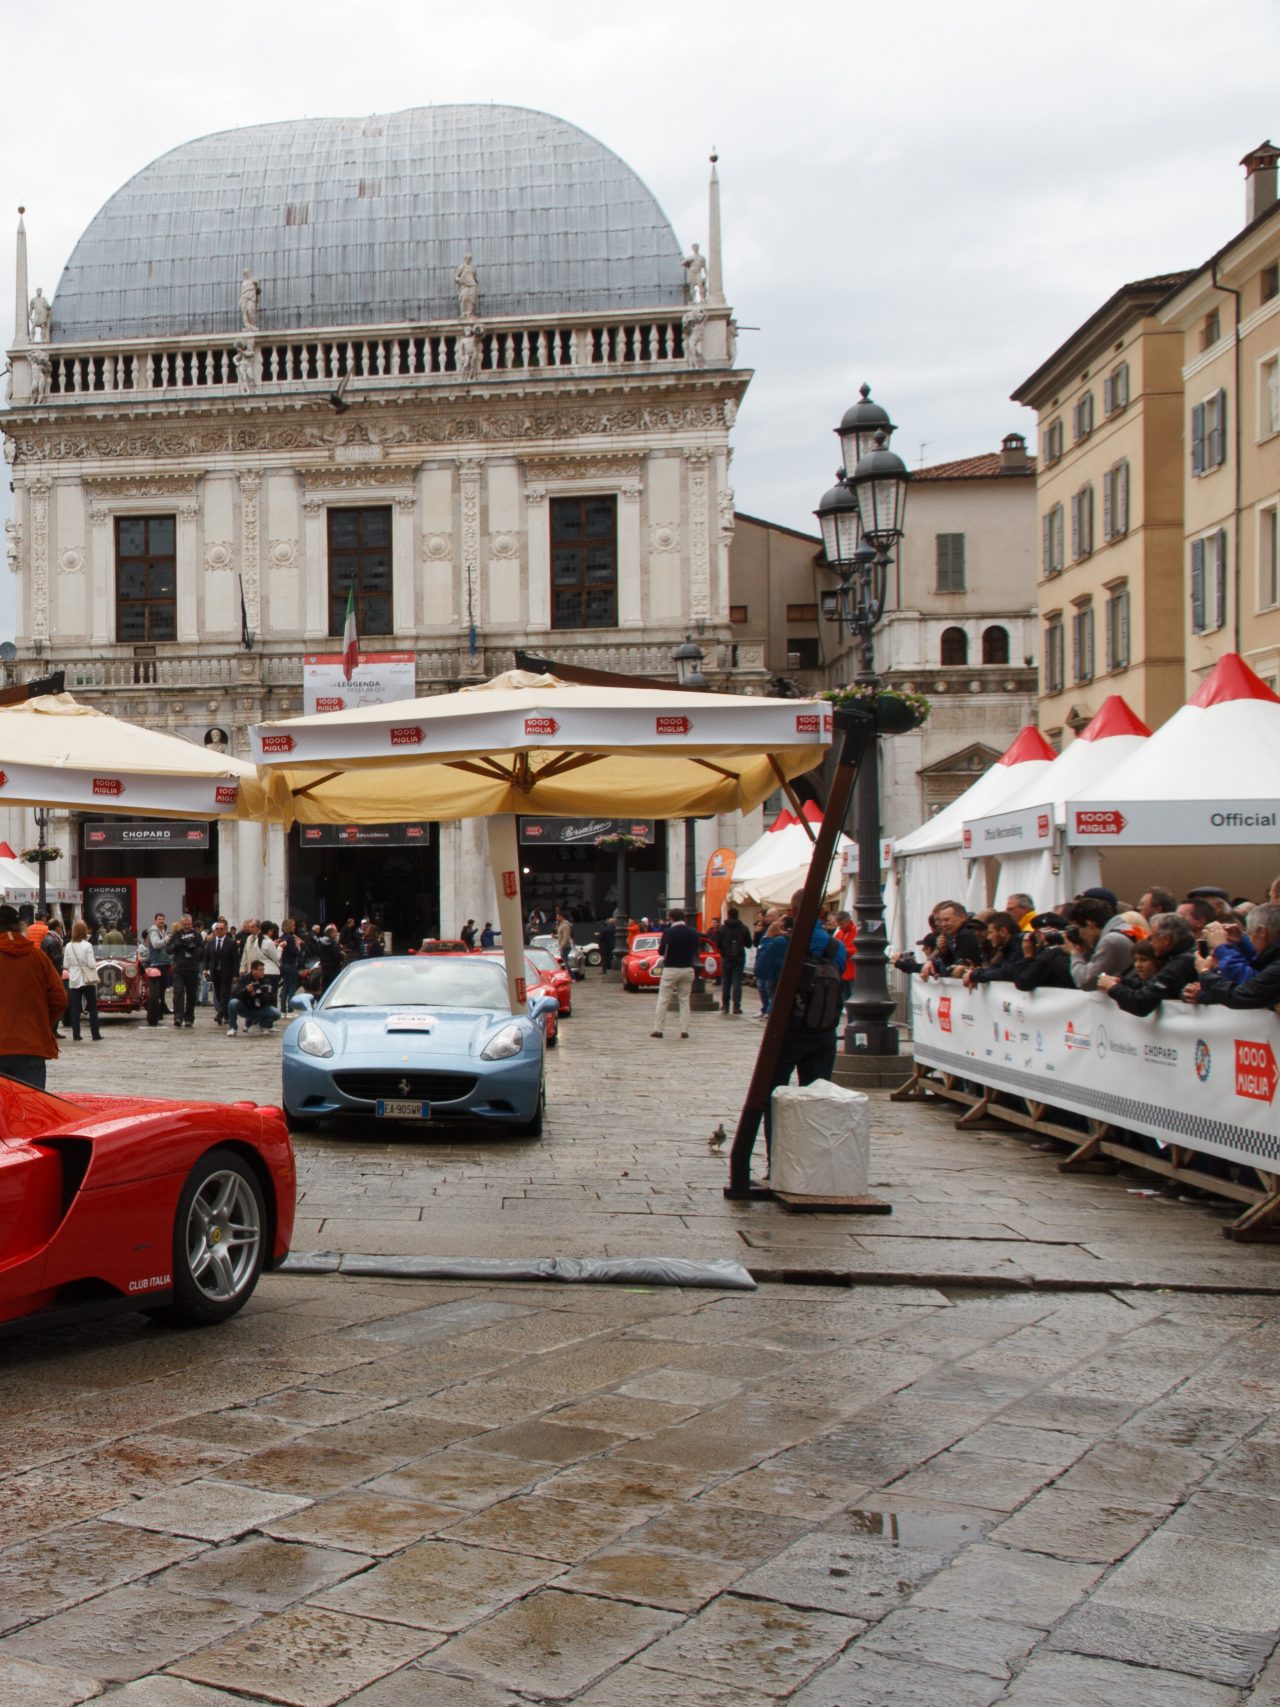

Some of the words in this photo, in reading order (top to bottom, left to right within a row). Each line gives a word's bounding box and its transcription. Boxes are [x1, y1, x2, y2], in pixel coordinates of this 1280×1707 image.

[319, 697, 339, 705] 1000
[659, 717, 683, 725] 1000
[393, 728, 417, 736] 1000
[526, 725, 552, 734] MIGLIA
[658, 725, 686, 733] MIGLIA
[392, 736, 418, 744] MIGLIA
[263, 744, 289, 752] MIGLIA
[95, 779, 117, 787] 1000
[93, 787, 118, 795] MIGLIA
[1079, 812, 1115, 822] 1000
[1210, 812, 1276, 827] Official
[561, 820, 612, 840] Borsalino
[1078, 823, 1118, 833] MIGLIA
[122, 830, 171, 838] CHOPARD
[88, 886, 127, 894] CHOPARD
[1144, 1044, 1178, 1061] CHOPARD
[1239, 1046, 1267, 1068] 1000
[1237, 1072, 1270, 1097] MIGLIA
[129, 1279, 148, 1291] CLUB
[150, 1274, 171, 1287] ITALIA
